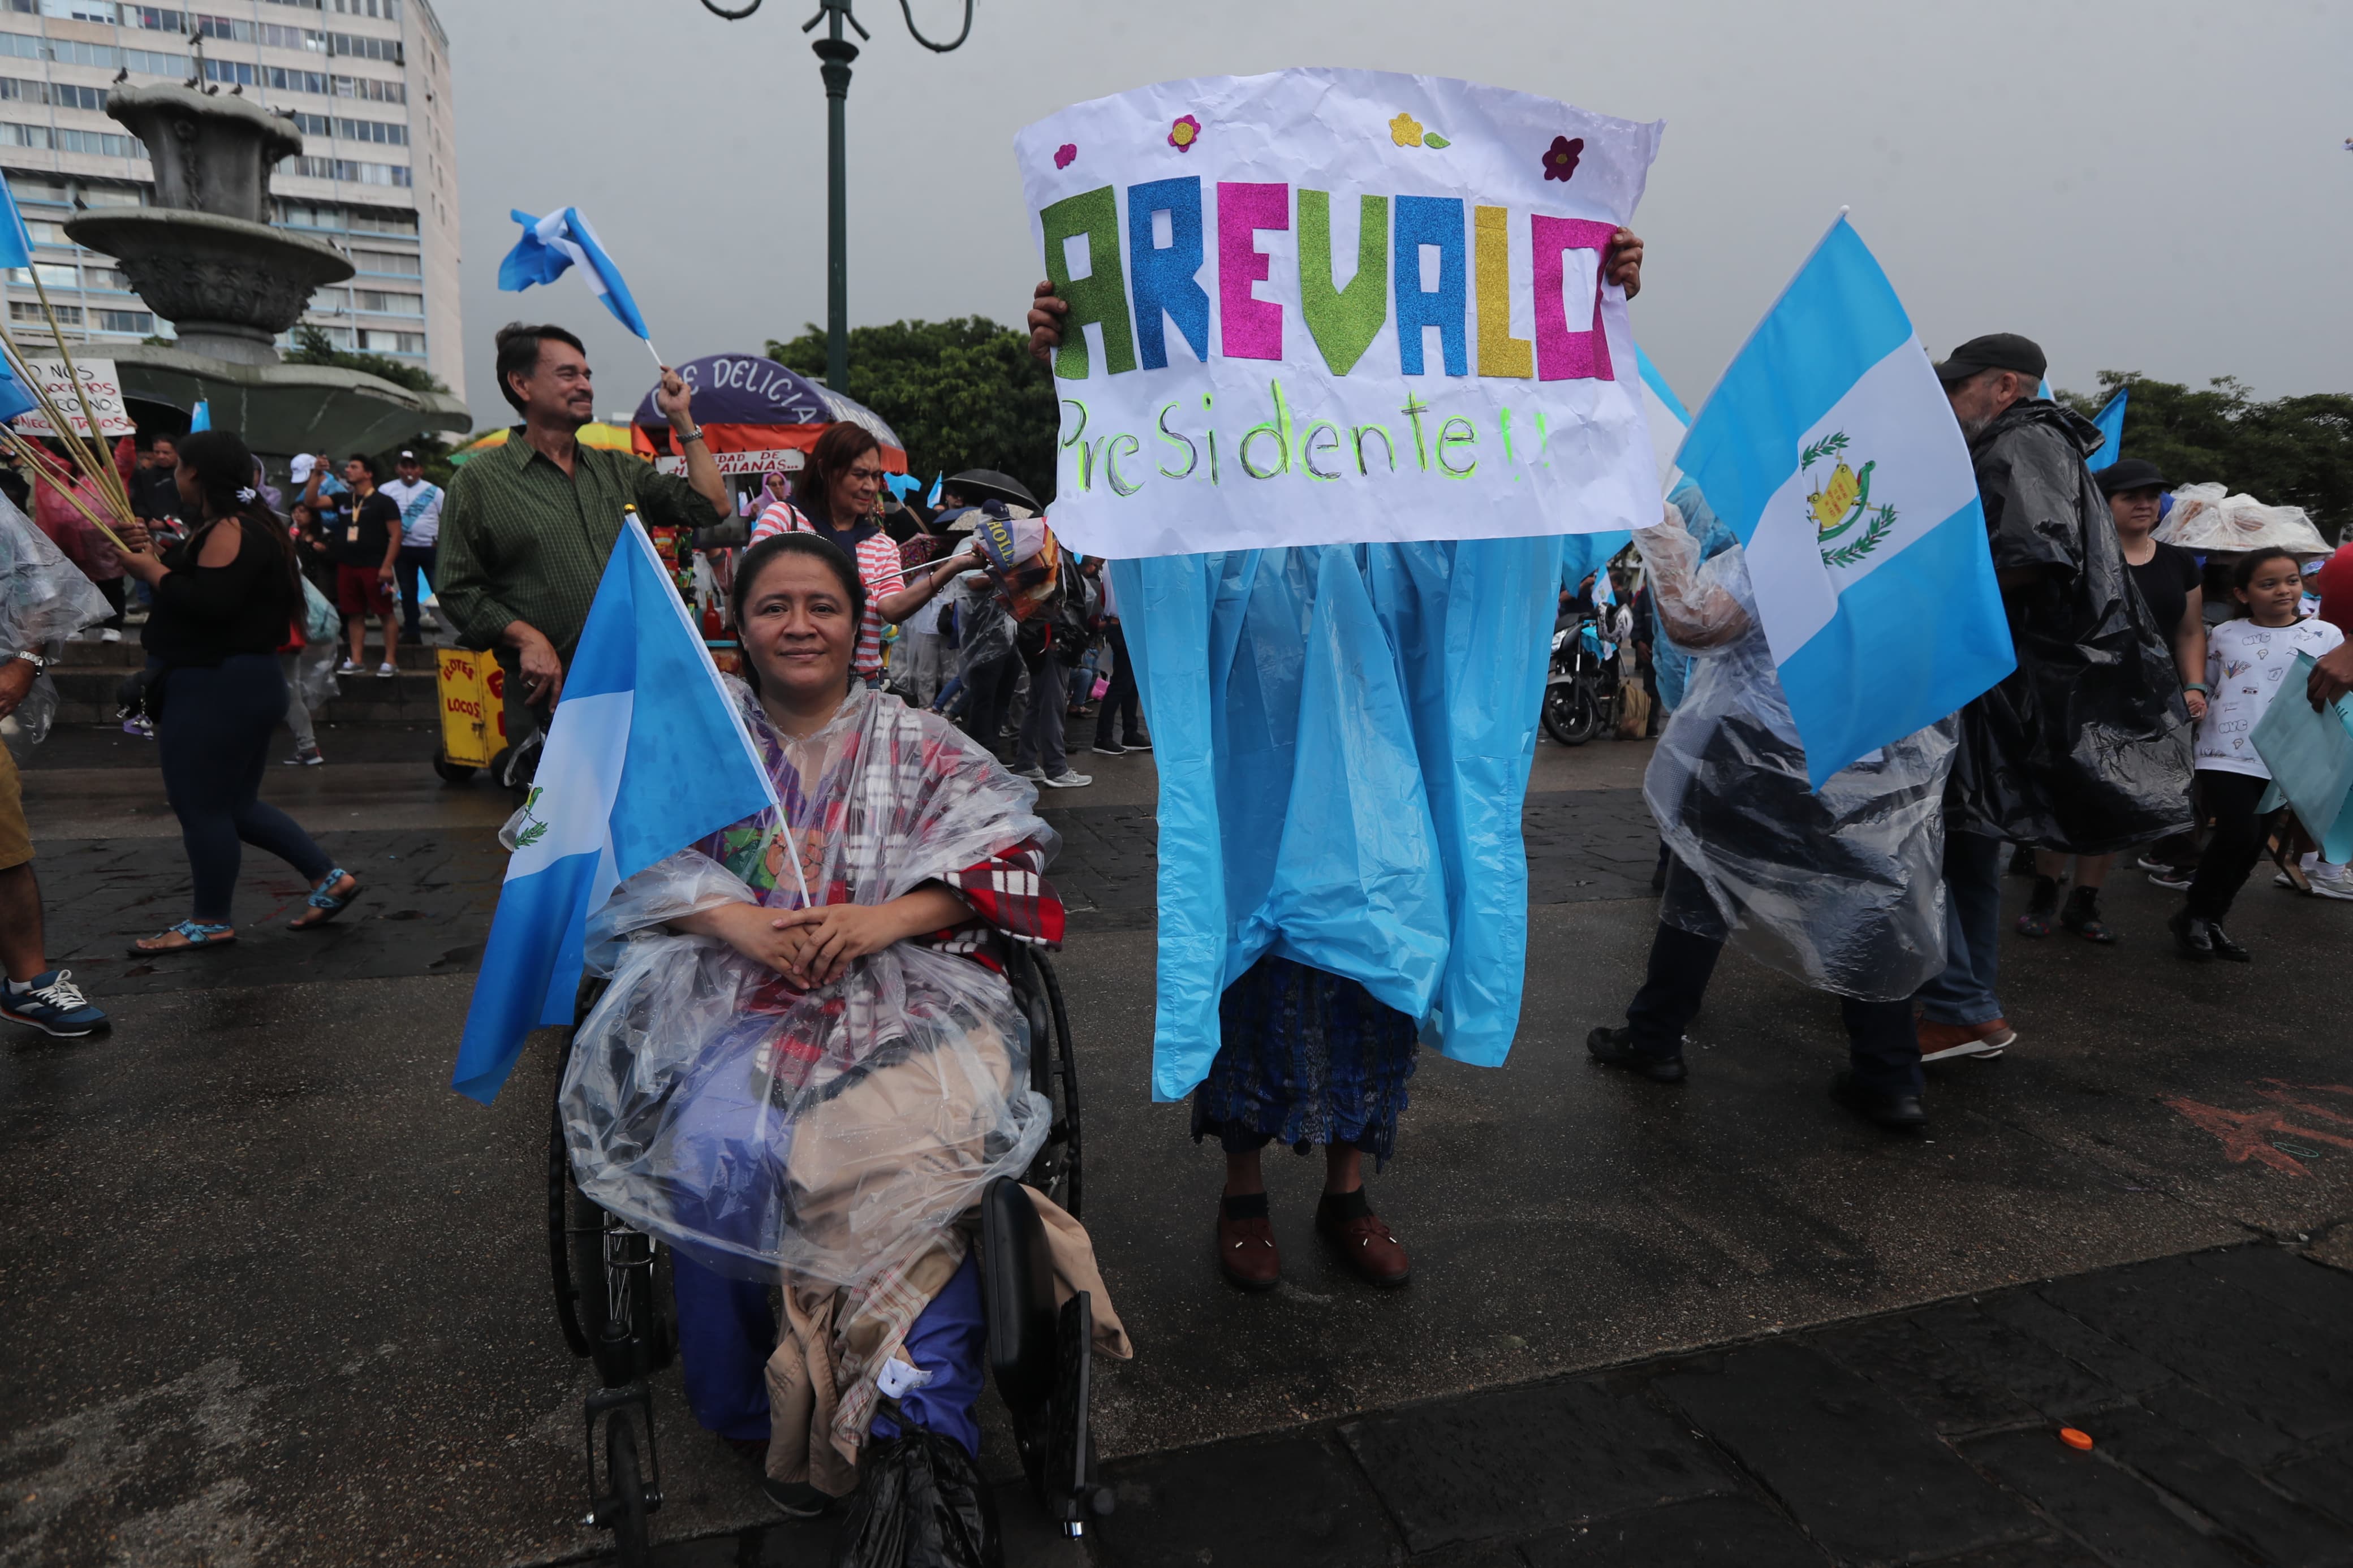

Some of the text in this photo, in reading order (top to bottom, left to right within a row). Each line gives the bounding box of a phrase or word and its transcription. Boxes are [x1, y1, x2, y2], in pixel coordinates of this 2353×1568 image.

[1040, 175, 1619, 382] AREVALO
[713, 358, 817, 425] DELICIA
[760, 451, 780, 460] DE
[443, 659, 475, 681] ELOTES
[447, 698, 480, 719] LOCOS
